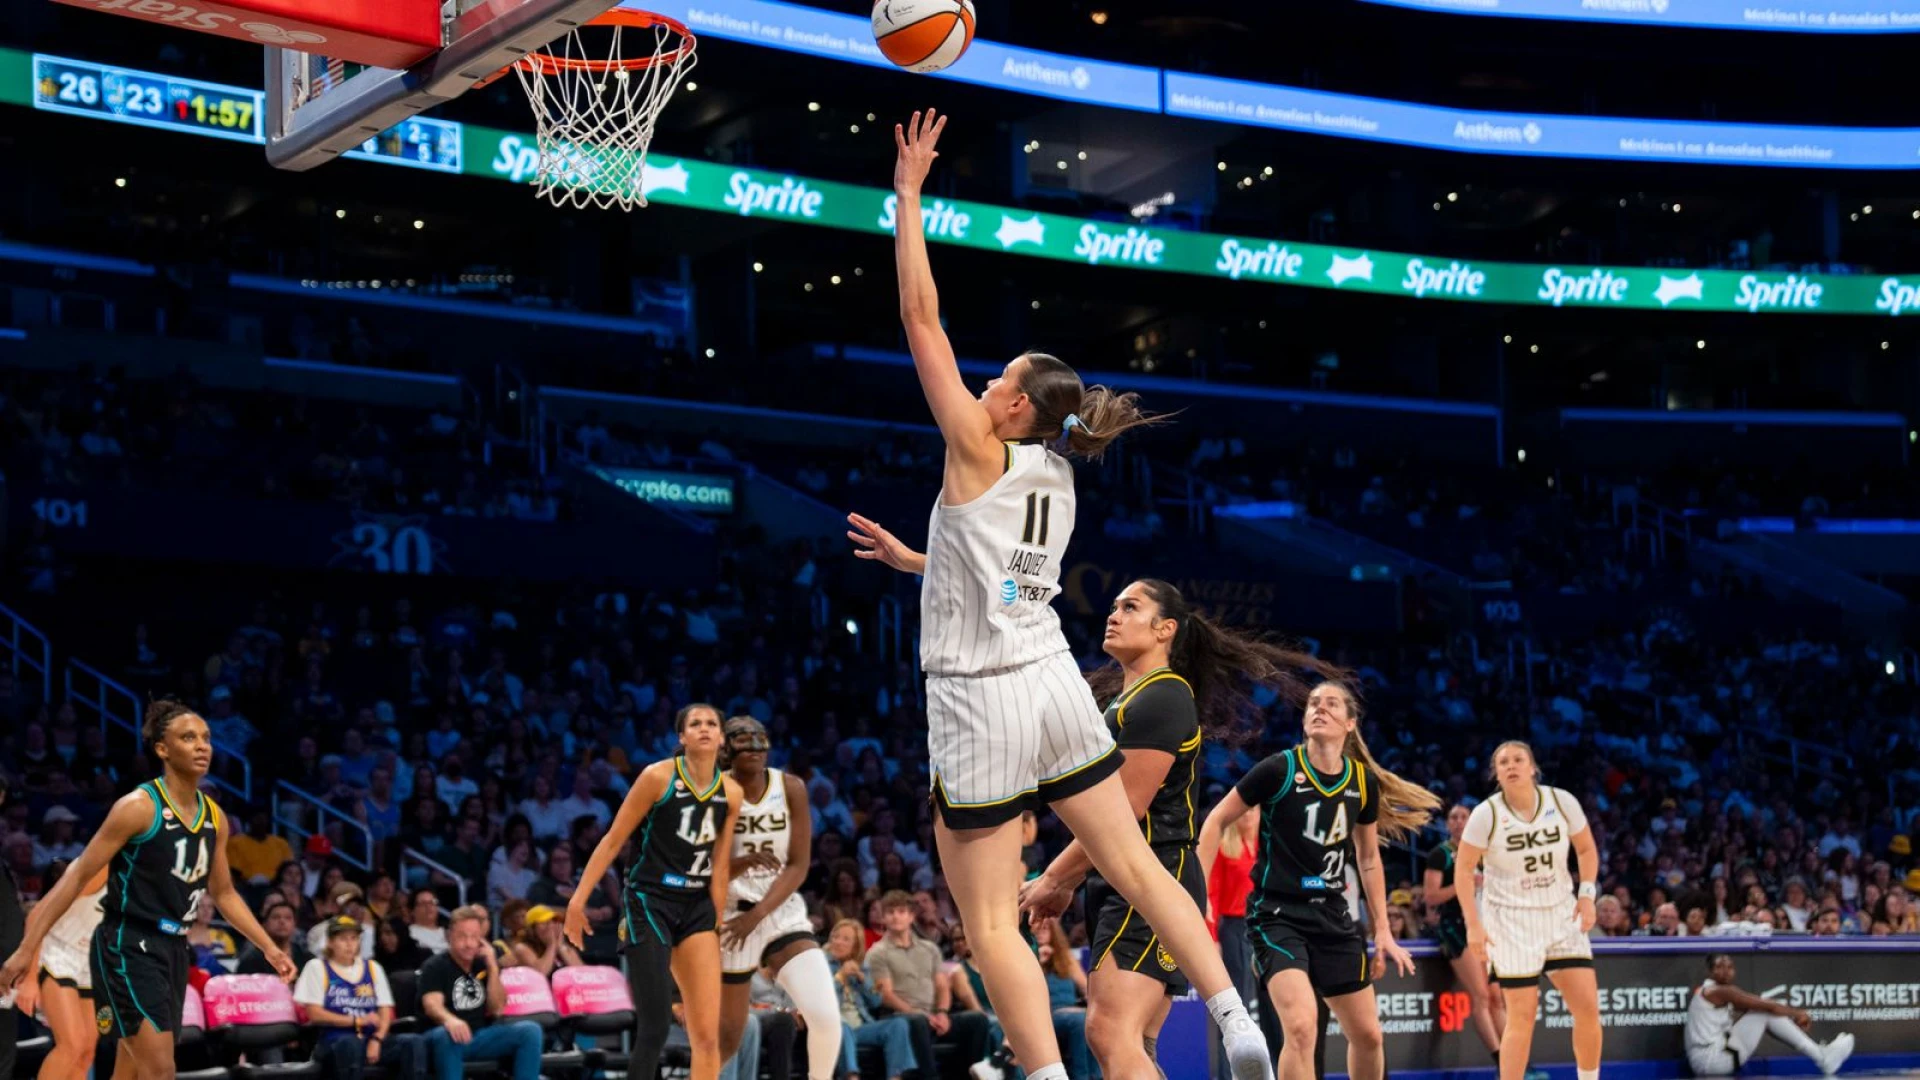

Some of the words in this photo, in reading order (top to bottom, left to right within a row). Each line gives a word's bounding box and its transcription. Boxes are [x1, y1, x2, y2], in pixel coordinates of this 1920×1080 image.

[59, 72, 98, 105] 26
[1002, 57, 1070, 88] Anthem
[126, 84, 163, 115] 23
[191, 95, 253, 130] 1:57
[1453, 120, 1522, 144] Anthem
[724, 171, 823, 216] Sprite
[877, 193, 972, 238] Srite
[1074, 223, 1165, 264] Sprite
[1216, 239, 1303, 280] Sprite
[1402, 258, 1486, 298] Sprite
[1538, 267, 1629, 306] Sprite
[1735, 275, 1824, 312] Sprite
[30, 497, 89, 529] 101
[1021, 491, 1050, 547] 11
[352, 523, 433, 575] 30
[676, 804, 716, 846] LA
[733, 812, 787, 834] SKY
[1302, 801, 1349, 847] LA
[1506, 825, 1561, 852] SKY
[170, 837, 210, 884] LA
[1319, 849, 1345, 880] 21
[1523, 851, 1553, 873] 24
[1377, 993, 1434, 1016] REET
[1612, 986, 1690, 1011] STREET
[1789, 984, 1848, 1007] STATE
[1850, 983, 1920, 1007] STREET
[1614, 1011, 1690, 1027] MANAGEMENT
